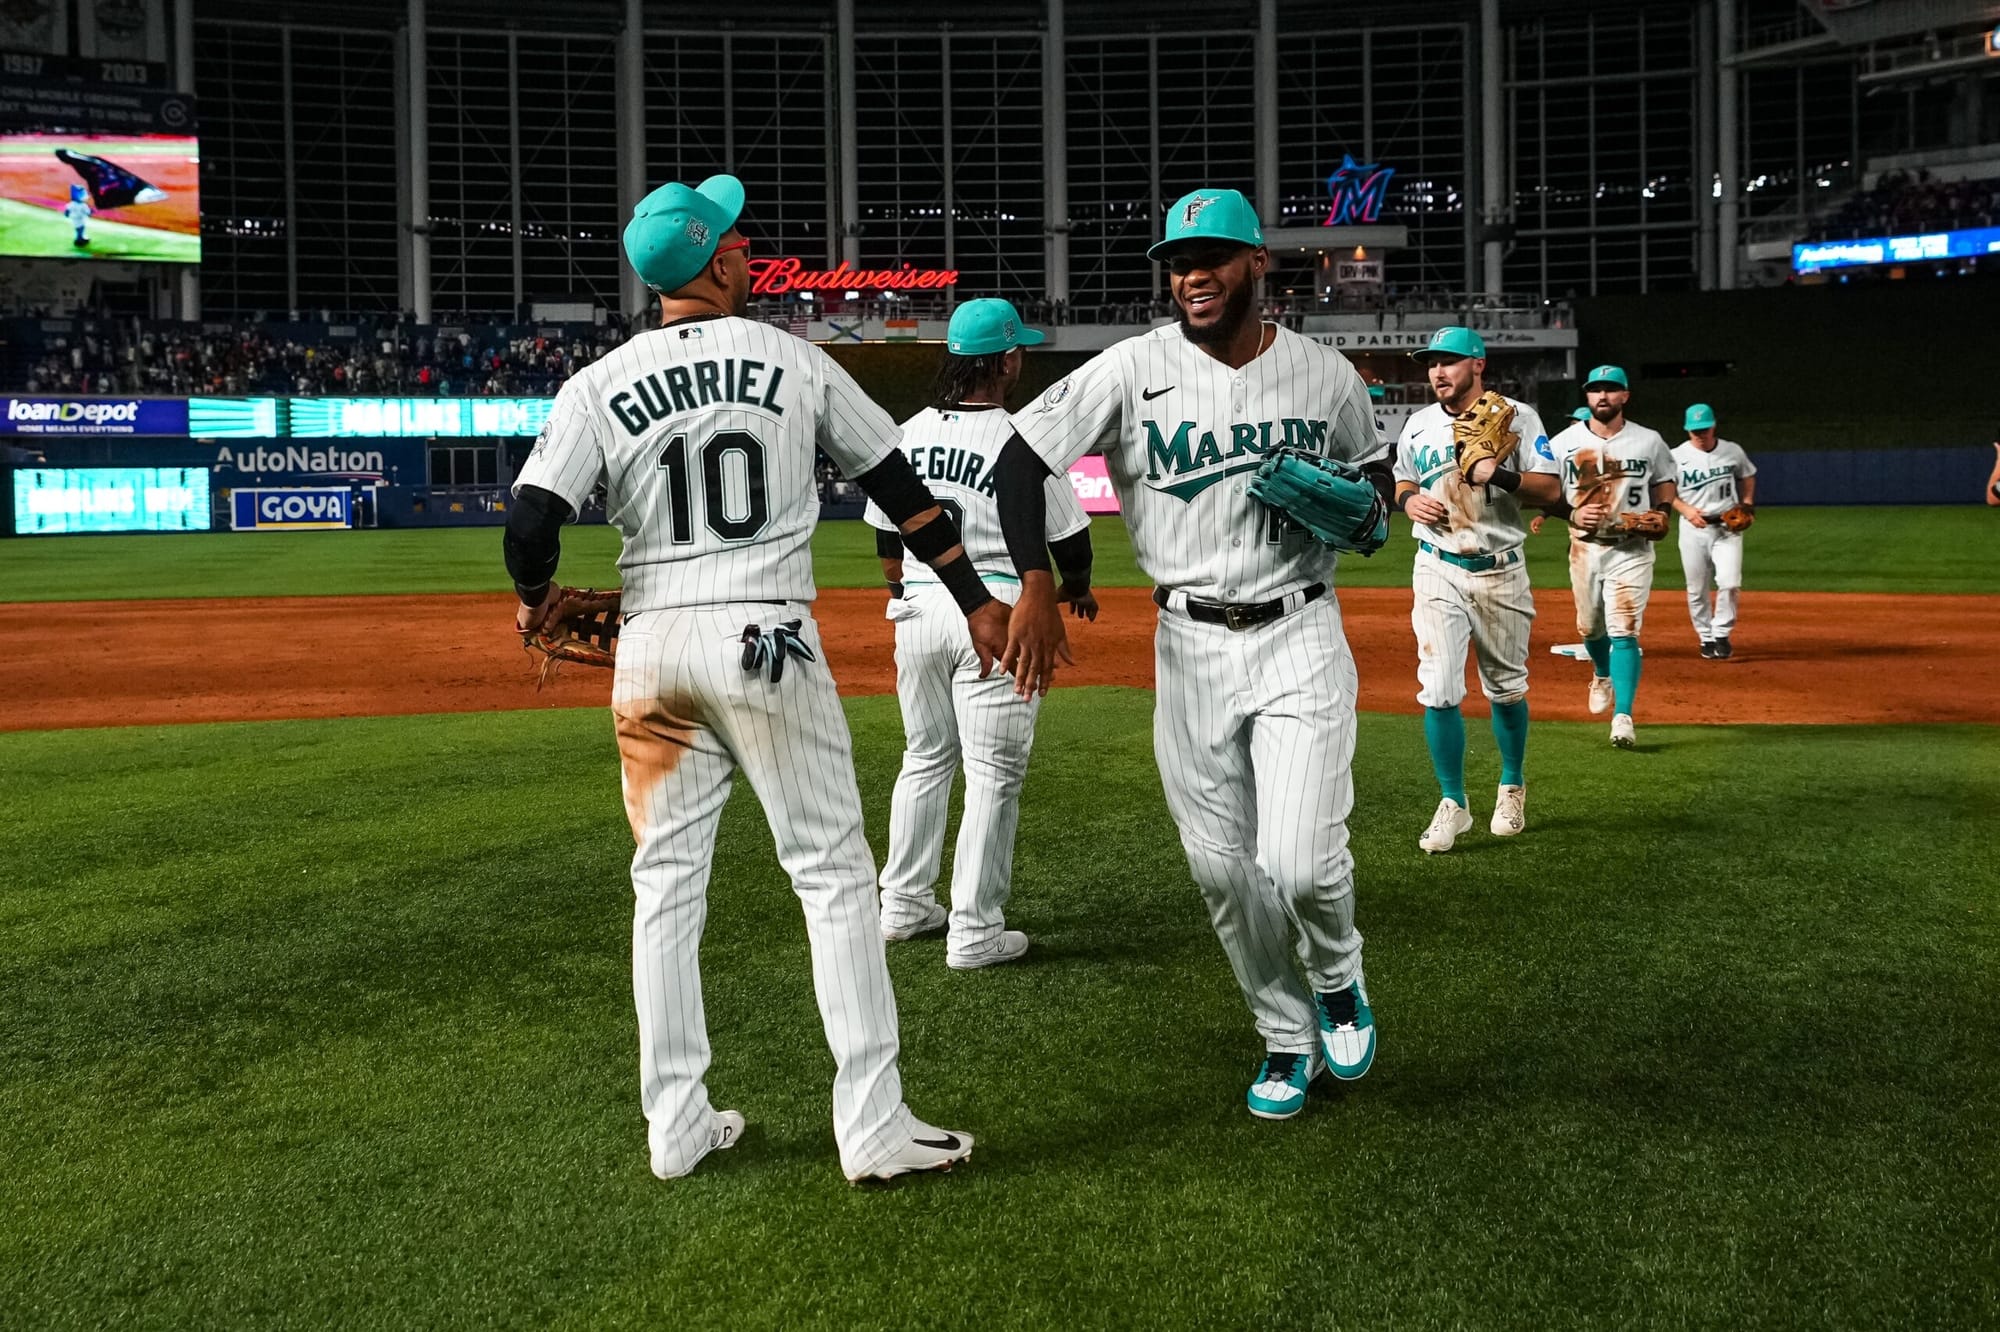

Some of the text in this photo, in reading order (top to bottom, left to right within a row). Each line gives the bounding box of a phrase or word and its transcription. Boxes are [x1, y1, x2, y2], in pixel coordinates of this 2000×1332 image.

[102, 63, 147, 83] 2003
[748, 257, 958, 294] Budweiser
[1357, 334, 1433, 346] PARTNE
[609, 358, 784, 436] GURRIEL
[8, 399, 138, 425] loanDepot
[213, 446, 383, 472] AutoNation
[911, 446, 994, 498] EGURA
[657, 429, 770, 545] 10
[1628, 486, 1643, 507] 5
[261, 496, 342, 521] GOYA
